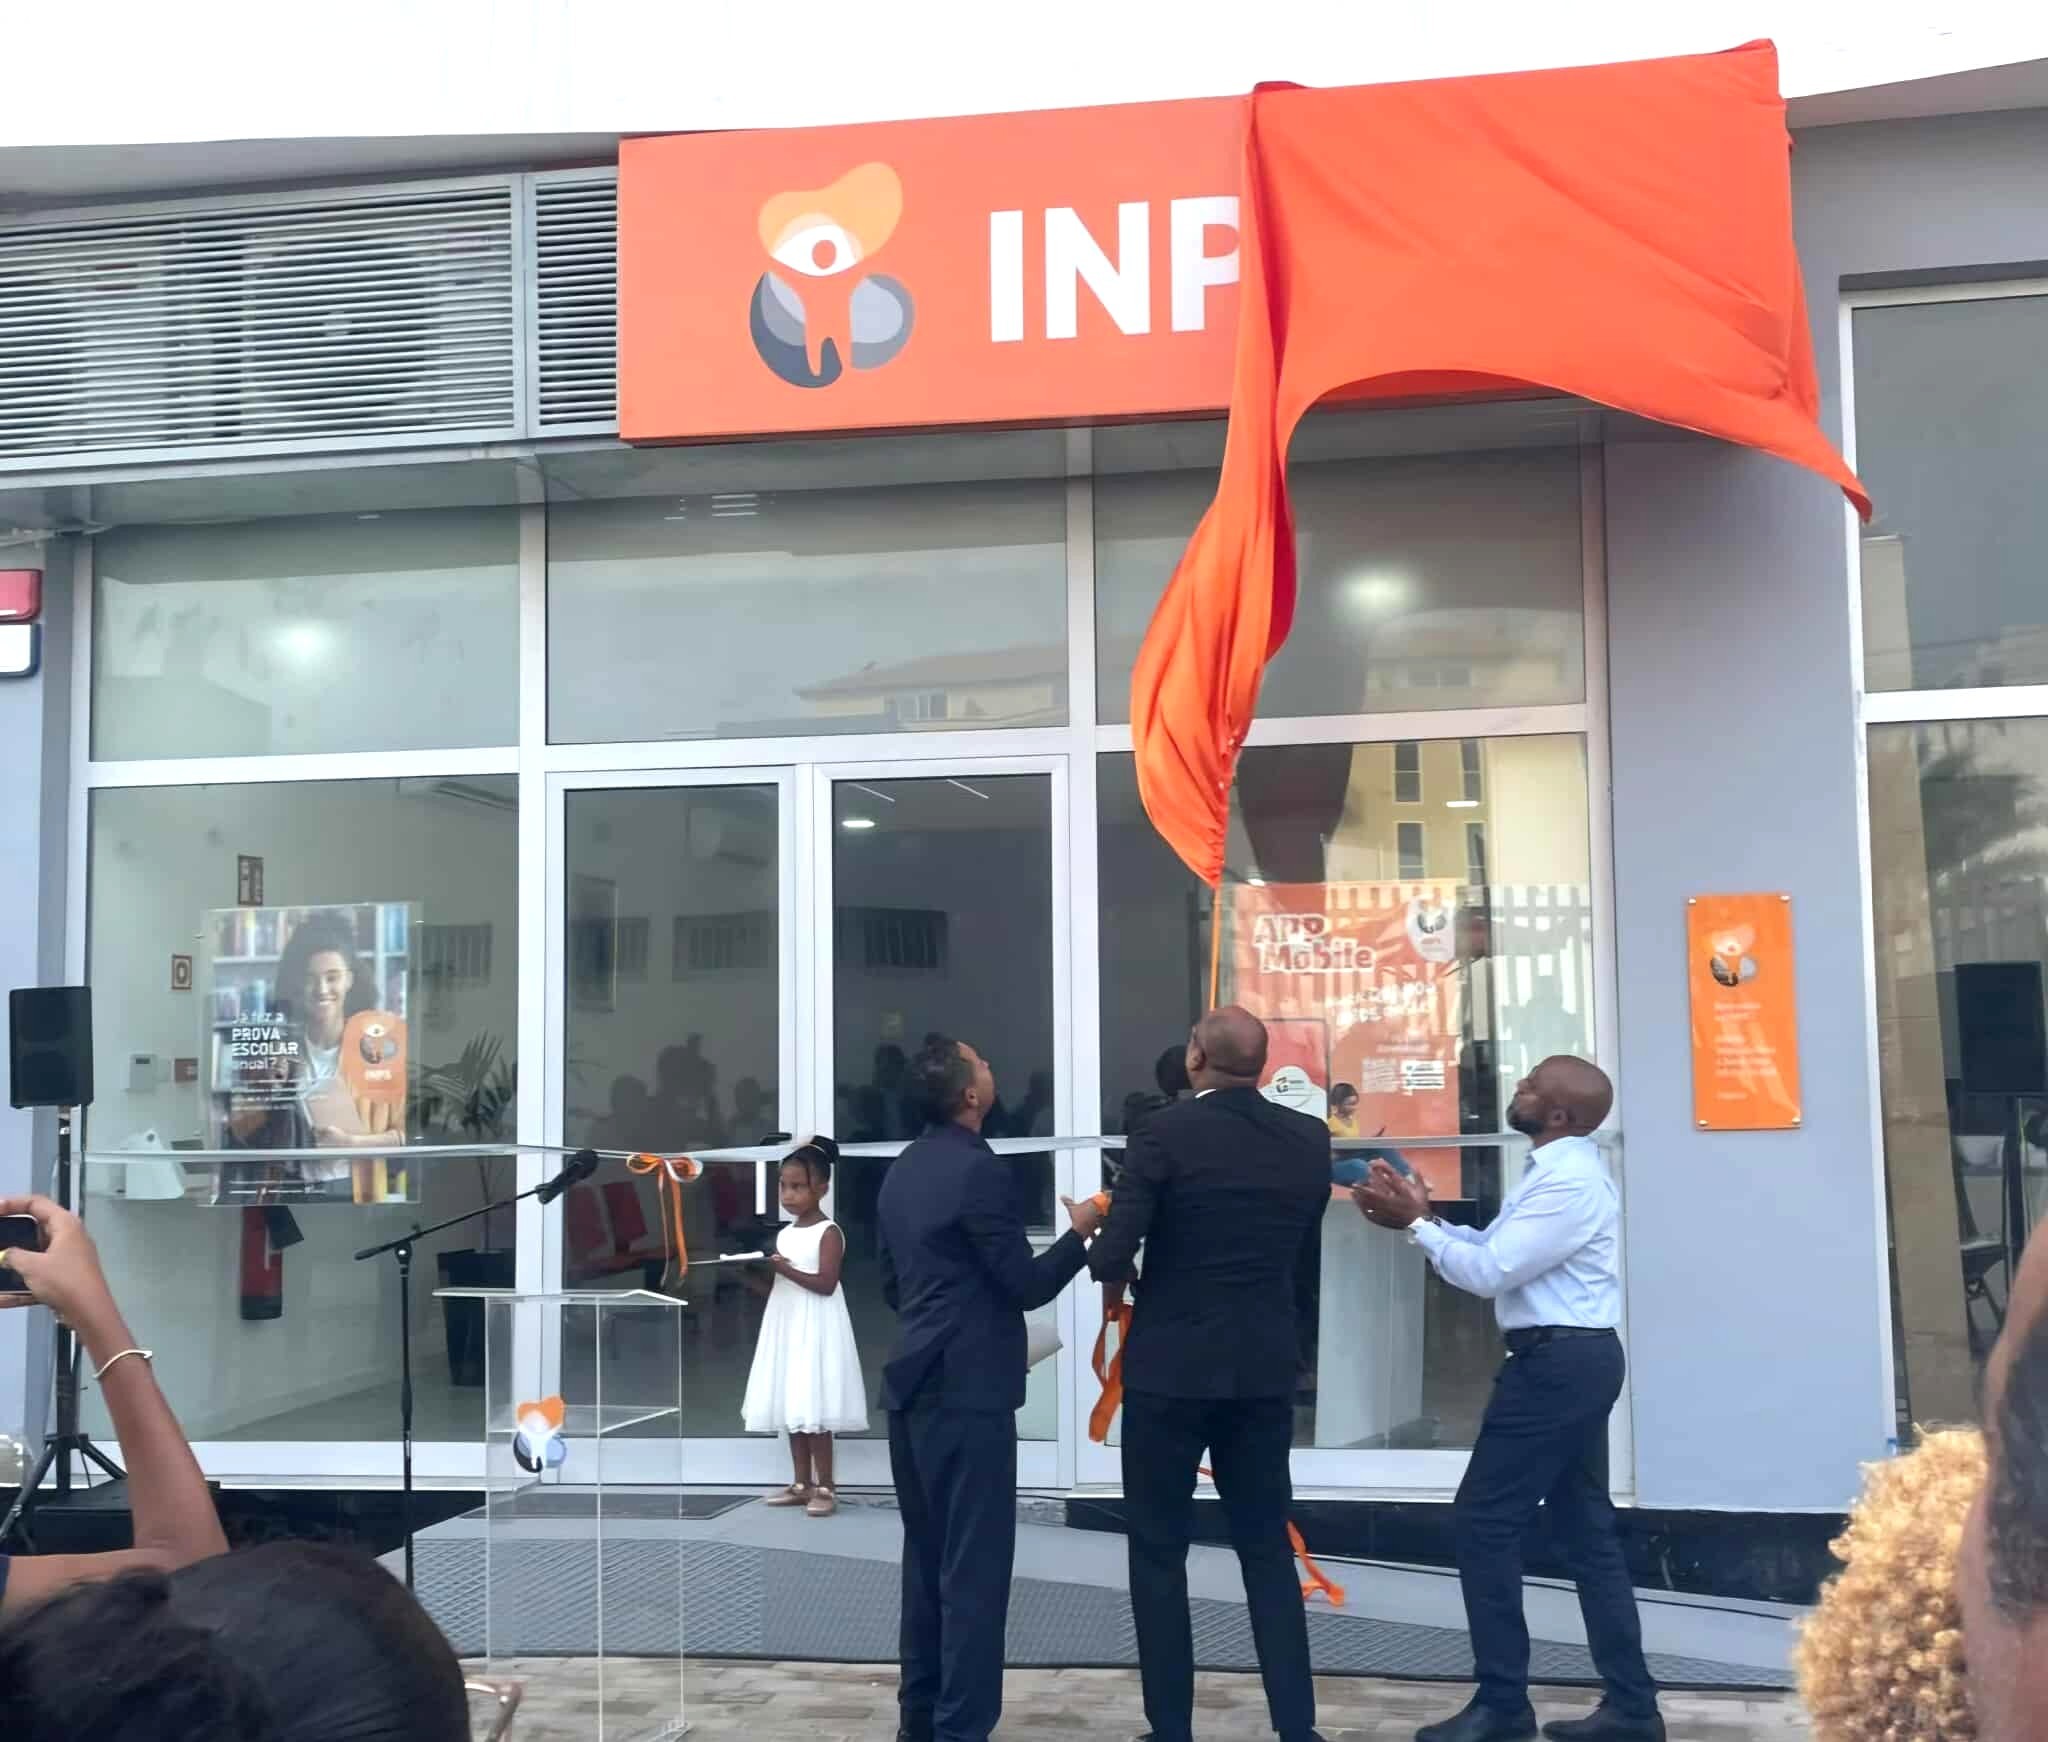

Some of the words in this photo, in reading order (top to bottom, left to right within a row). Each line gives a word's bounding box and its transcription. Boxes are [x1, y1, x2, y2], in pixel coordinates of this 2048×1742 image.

[989, 195, 1240, 343] INP
[1261, 940, 1375, 972] Mobile
[231, 1027, 281, 1041] PROVA
[231, 1041, 299, 1056] ESCOLAR
